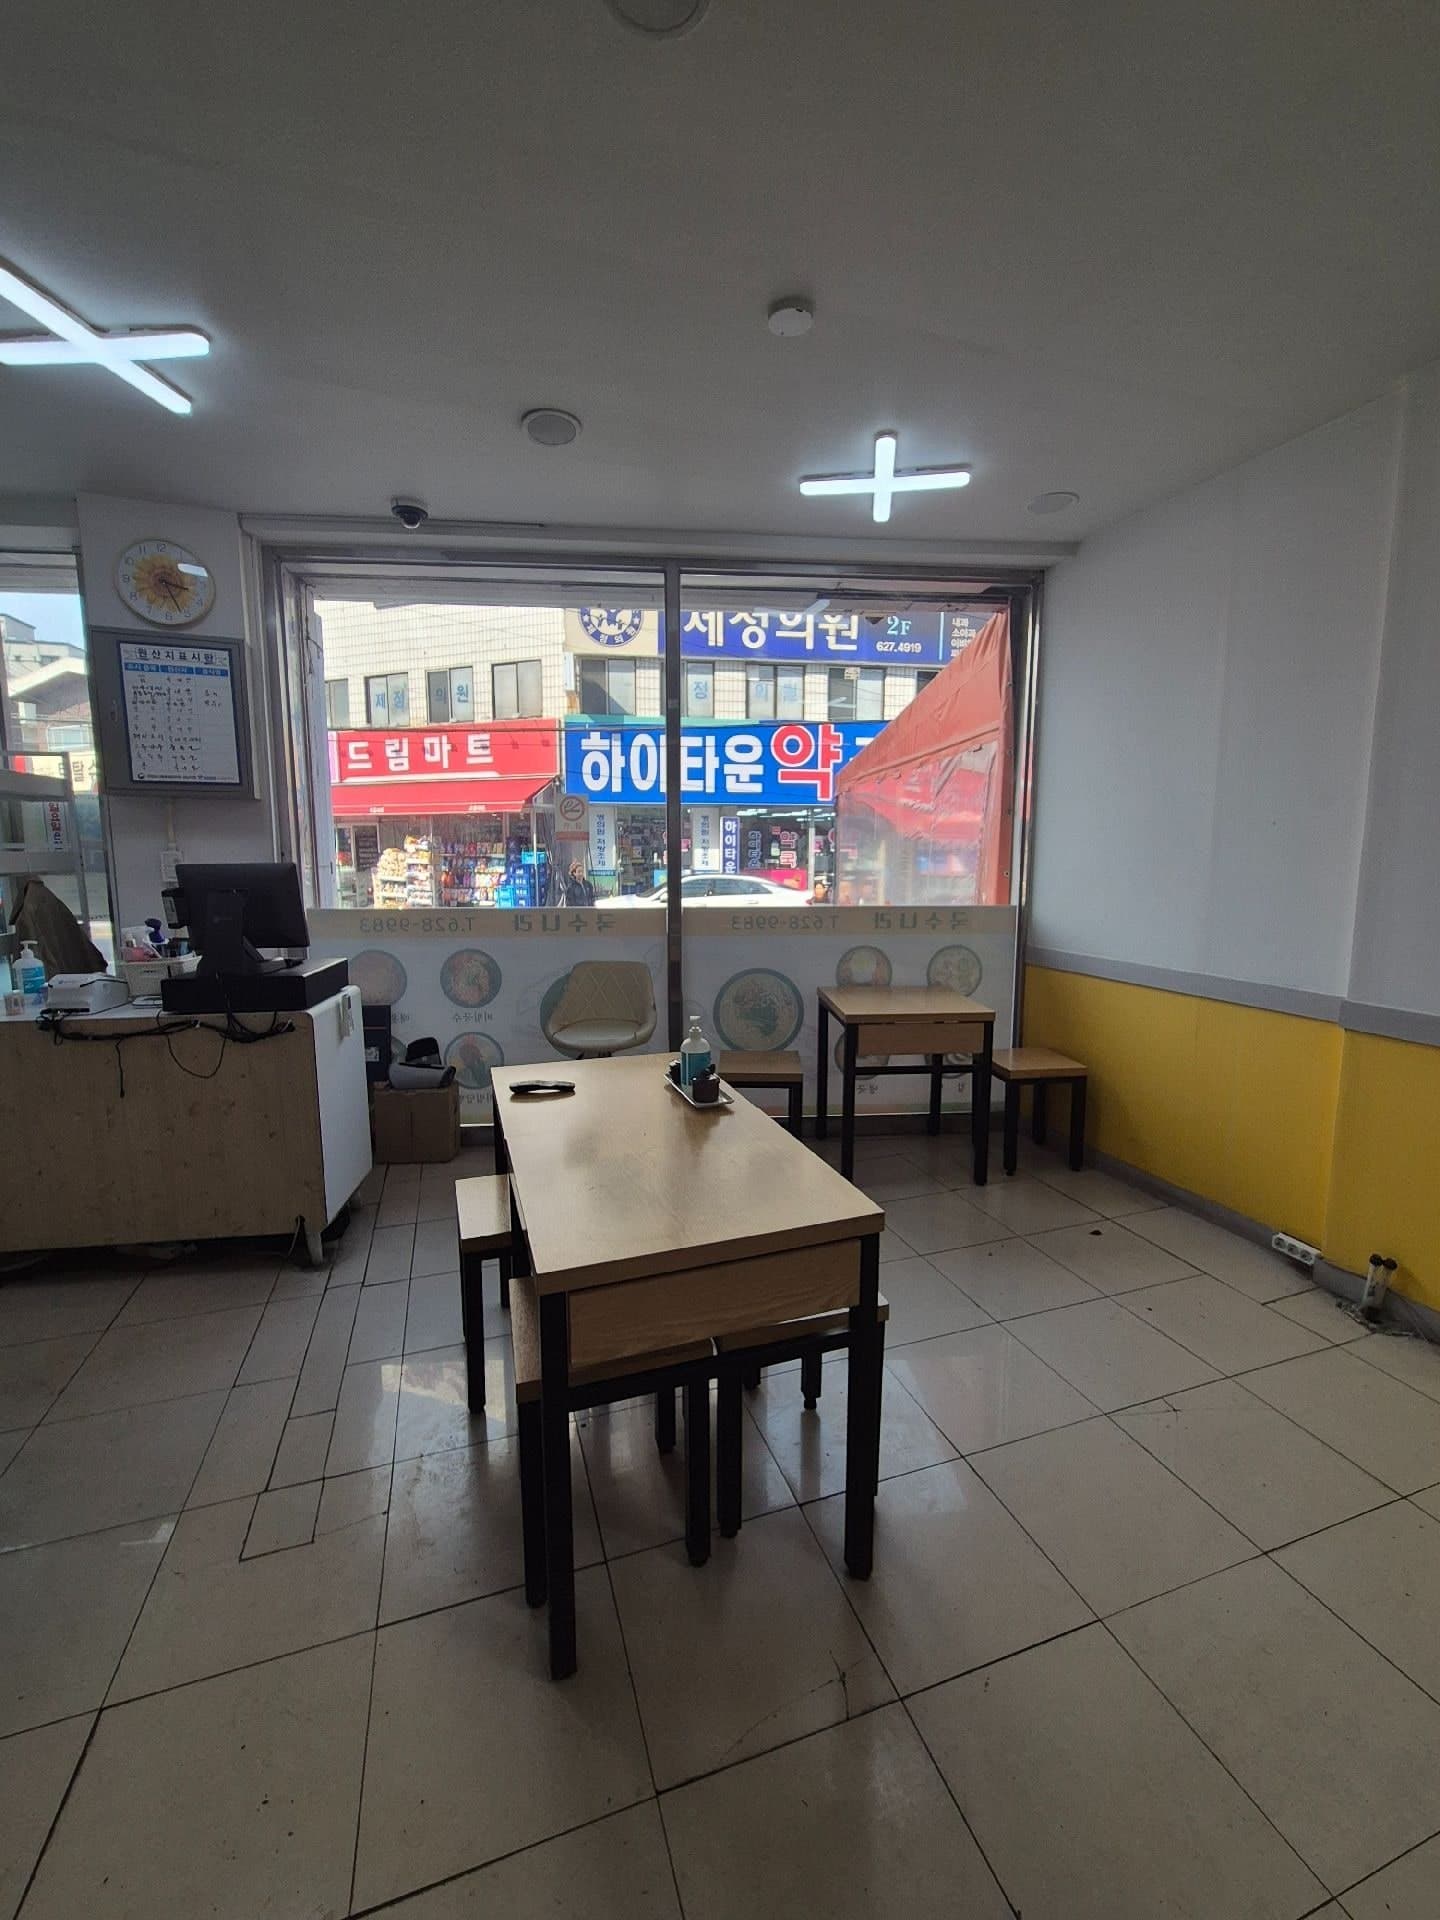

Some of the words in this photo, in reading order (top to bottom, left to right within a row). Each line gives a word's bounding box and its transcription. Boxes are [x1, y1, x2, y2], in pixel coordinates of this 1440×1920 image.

[887, 616, 912, 635] 2F
[876, 641, 922, 653] 627.4919
[348, 733, 494, 771] 드림마트
[581, 732, 764, 793] 하이타운
